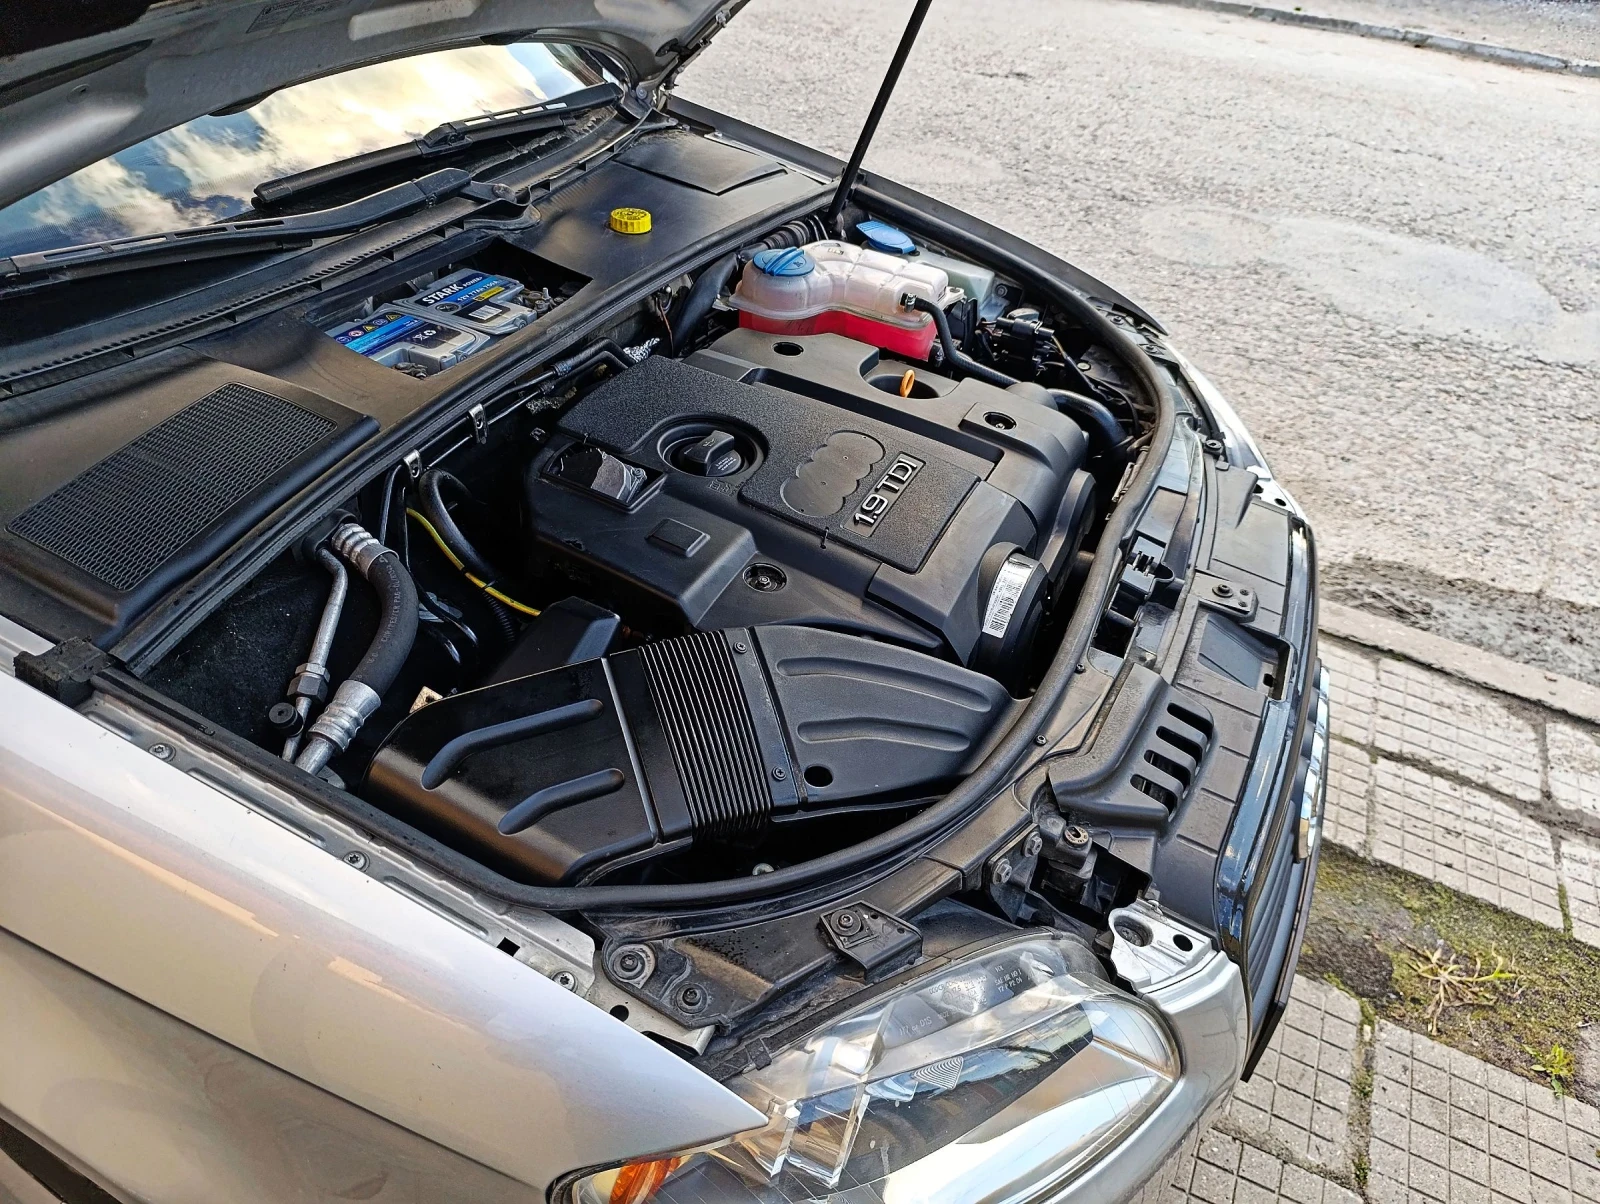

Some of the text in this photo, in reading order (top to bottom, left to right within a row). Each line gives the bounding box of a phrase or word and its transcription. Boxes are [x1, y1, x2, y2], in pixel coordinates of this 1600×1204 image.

[422, 284, 464, 304] STARK
[855, 458, 918, 524] 1.9 TDI
